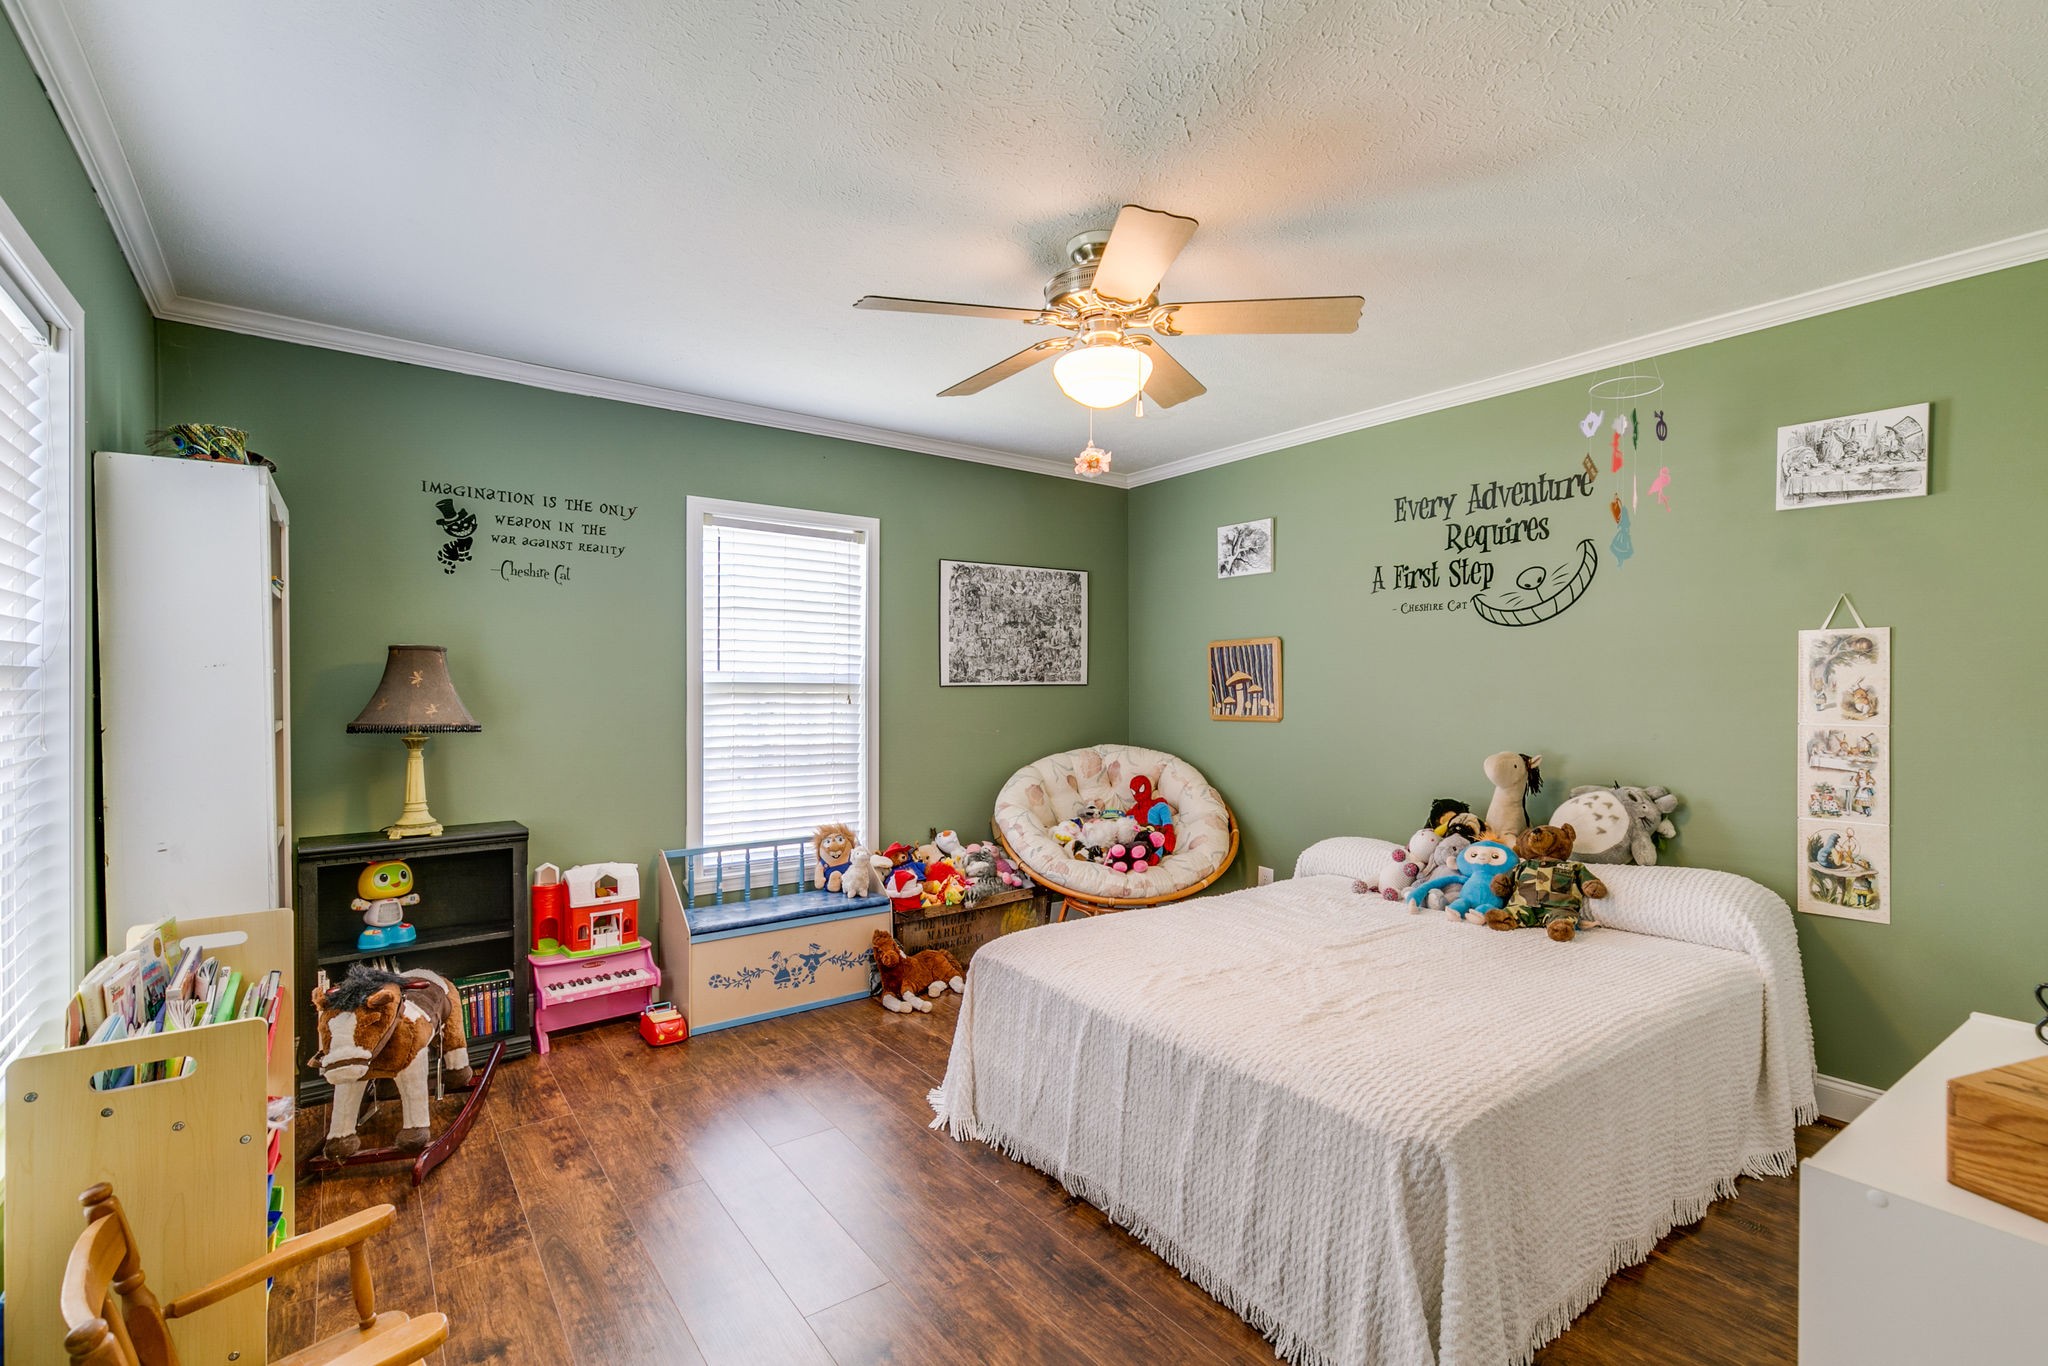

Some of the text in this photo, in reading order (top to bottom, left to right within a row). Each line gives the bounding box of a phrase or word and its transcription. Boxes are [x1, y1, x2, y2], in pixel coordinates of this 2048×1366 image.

[542, 495, 557, 509] IS
[564, 499, 593, 512] THE
[1393, 472, 1594, 524] Every Adventure
[558, 521, 574, 533] IN
[581, 523, 607, 536] THE
[1444, 516, 1550, 554] Requires
[554, 564, 571, 585] Cat
[1370, 557, 1494, 595] A First Step
[927, 923, 972, 940] MARKET
